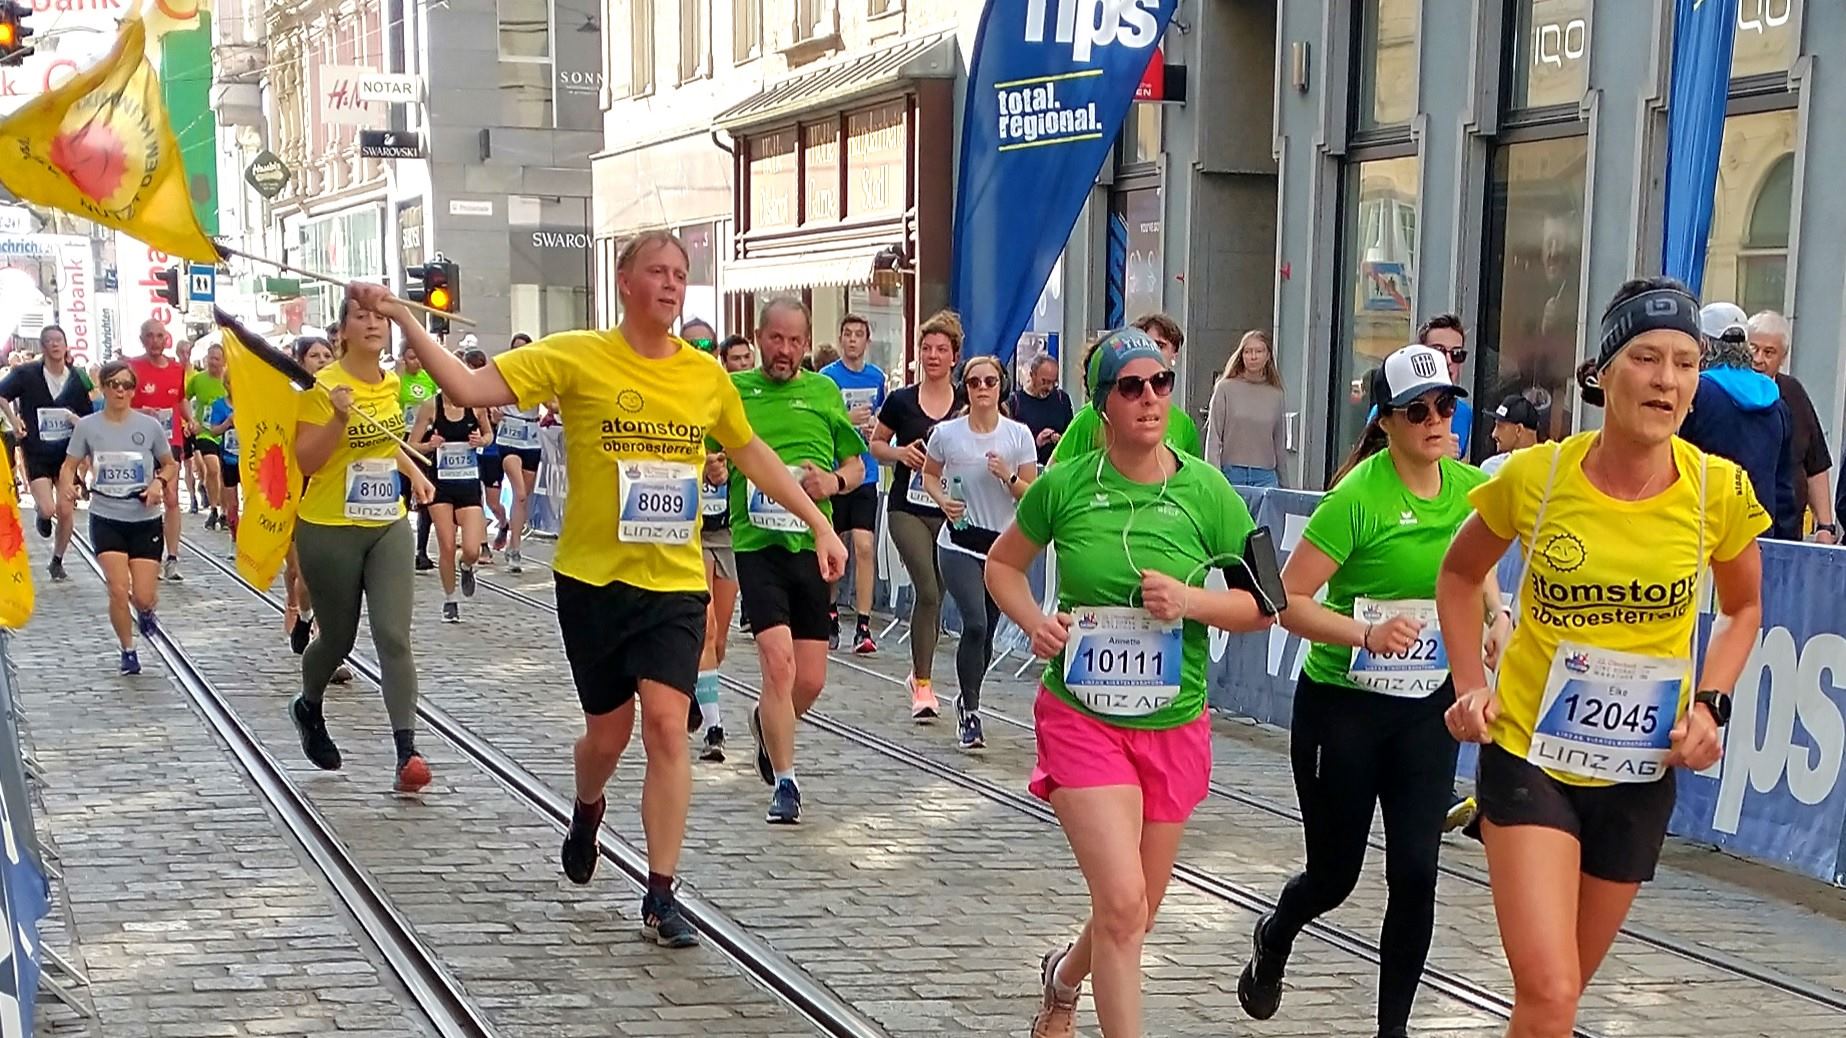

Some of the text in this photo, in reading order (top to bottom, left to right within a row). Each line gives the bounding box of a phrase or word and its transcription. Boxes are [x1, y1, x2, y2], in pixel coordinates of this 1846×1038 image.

[363, 81, 412, 94] NOTAR
[998, 82, 1061, 116] total.
[999, 103, 1103, 141] regional.
[362, 146, 418, 157] SWAROVSKI
[444, 455, 473, 466] 10175
[102, 468, 137, 480] 13753
[360, 481, 393, 497] 8100
[638, 493, 684, 514] 8089
[623, 526, 689, 540] LINZ AG
[1082, 647, 1163, 676] 10111
[1409, 679, 1440, 691] AG
[1609, 686, 1629, 697] Elke
[1074, 690, 1128, 708] INZ
[1564, 693, 1660, 734] 12045
[1539, 741, 1658, 776] LINZ AG
